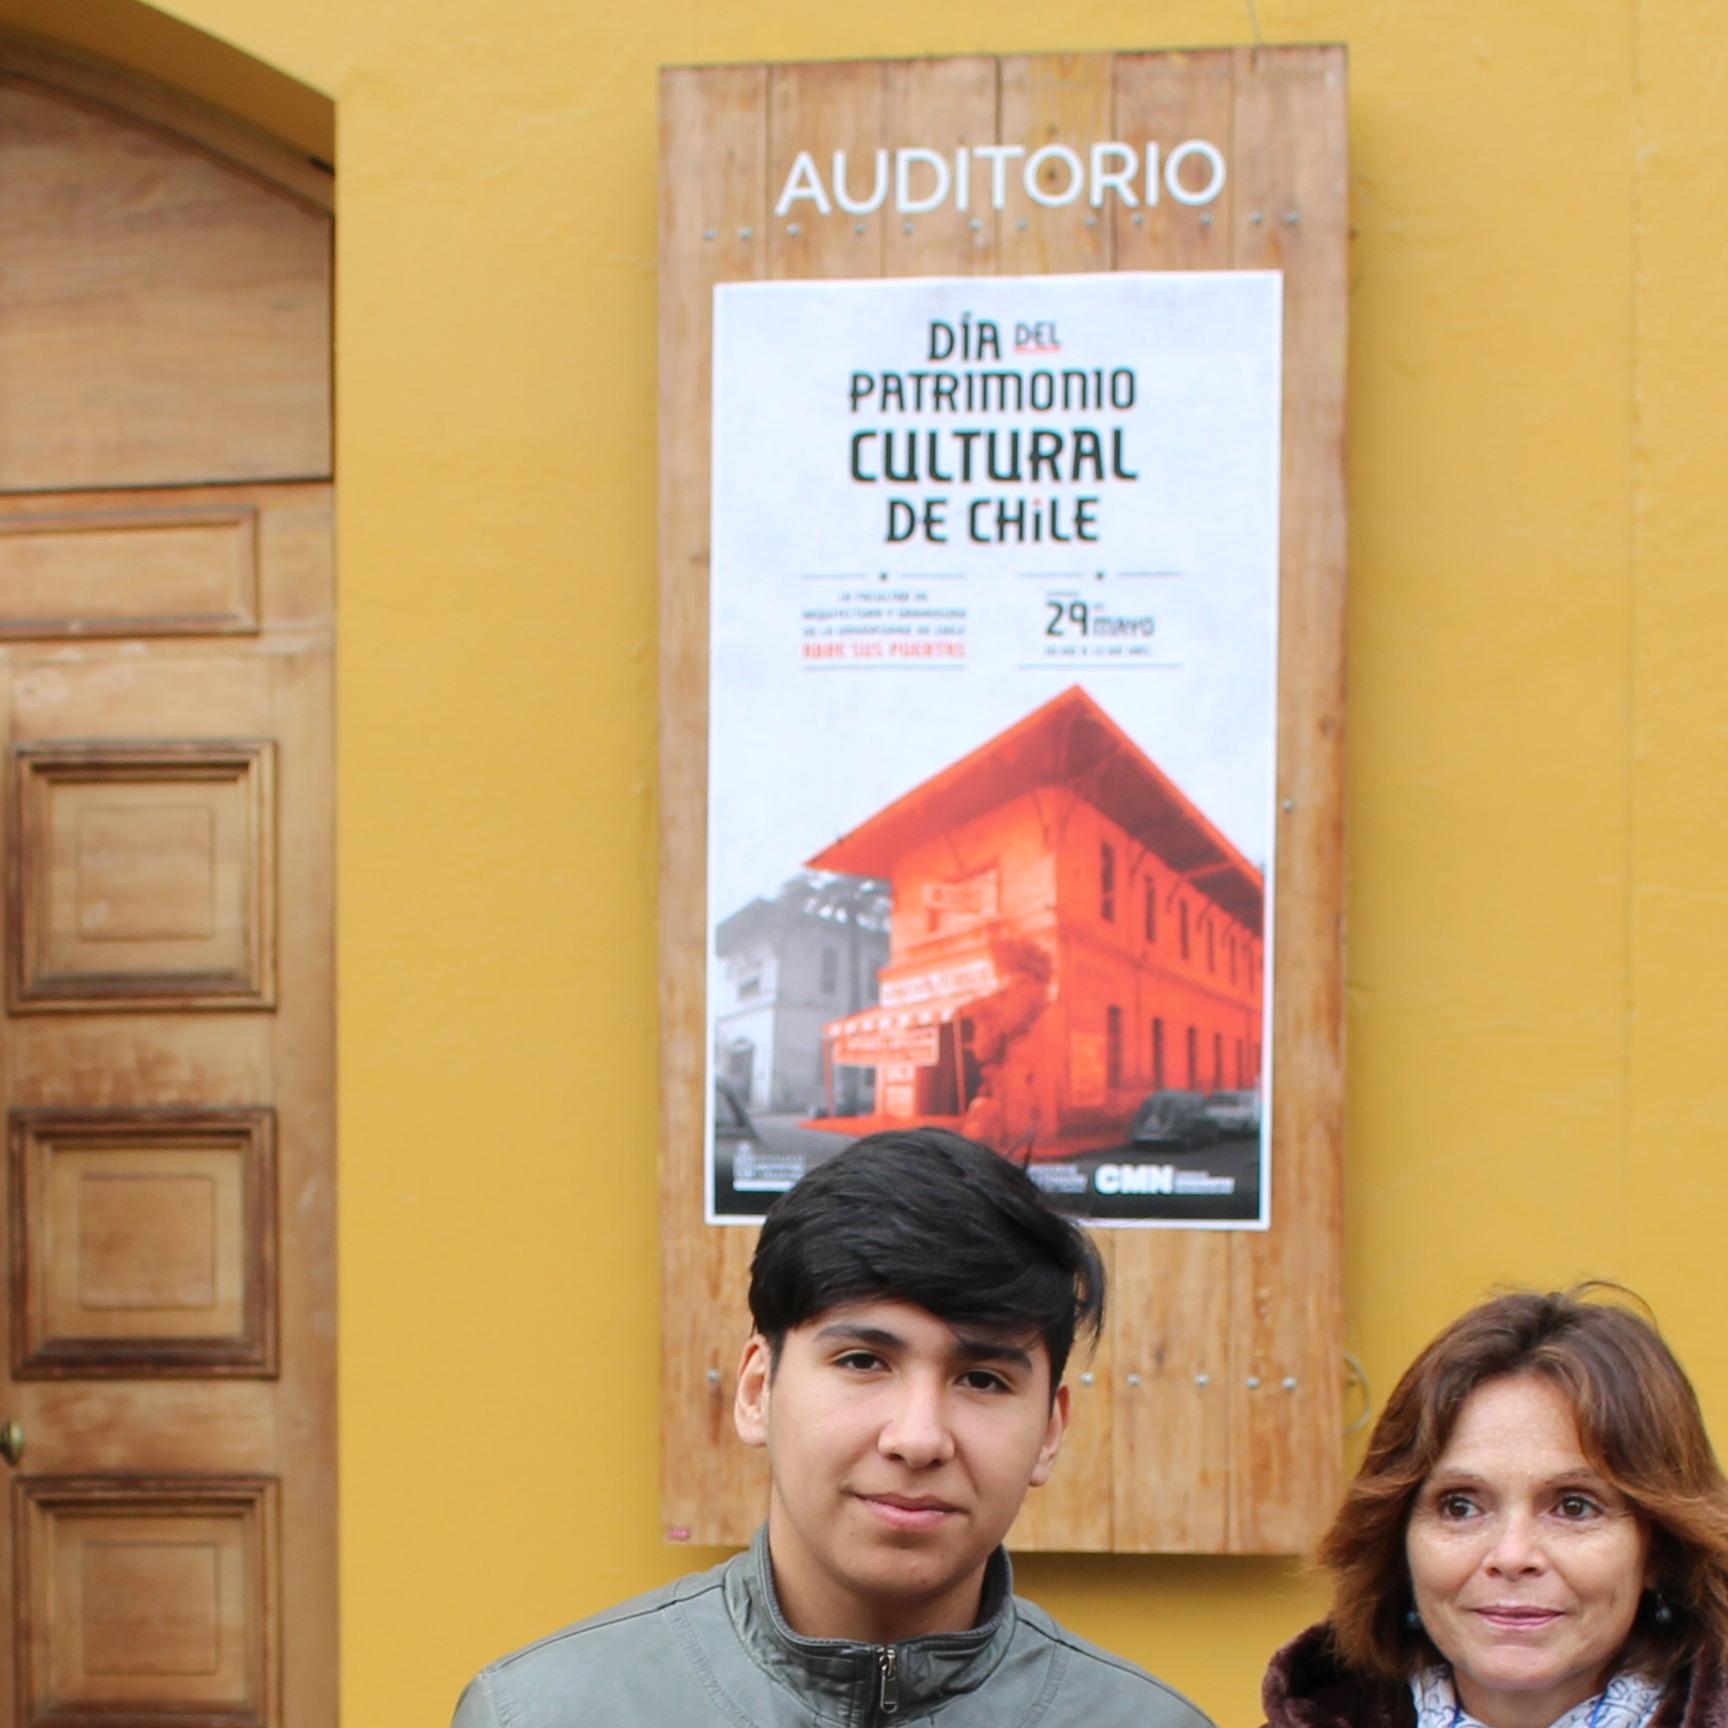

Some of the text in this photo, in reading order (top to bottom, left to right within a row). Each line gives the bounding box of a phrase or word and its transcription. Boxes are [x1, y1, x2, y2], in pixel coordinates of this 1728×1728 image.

[774, 140, 1227, 216] AUDITORIO
[928, 310, 1062, 361] DÍA DEL
[850, 367, 1136, 413] PATRIMONIO
[850, 428, 1139, 483] CULTURAL
[885, 498, 948, 543] DE
[1045, 601, 1088, 637] 29
[1094, 1163, 1176, 1195] CMN
